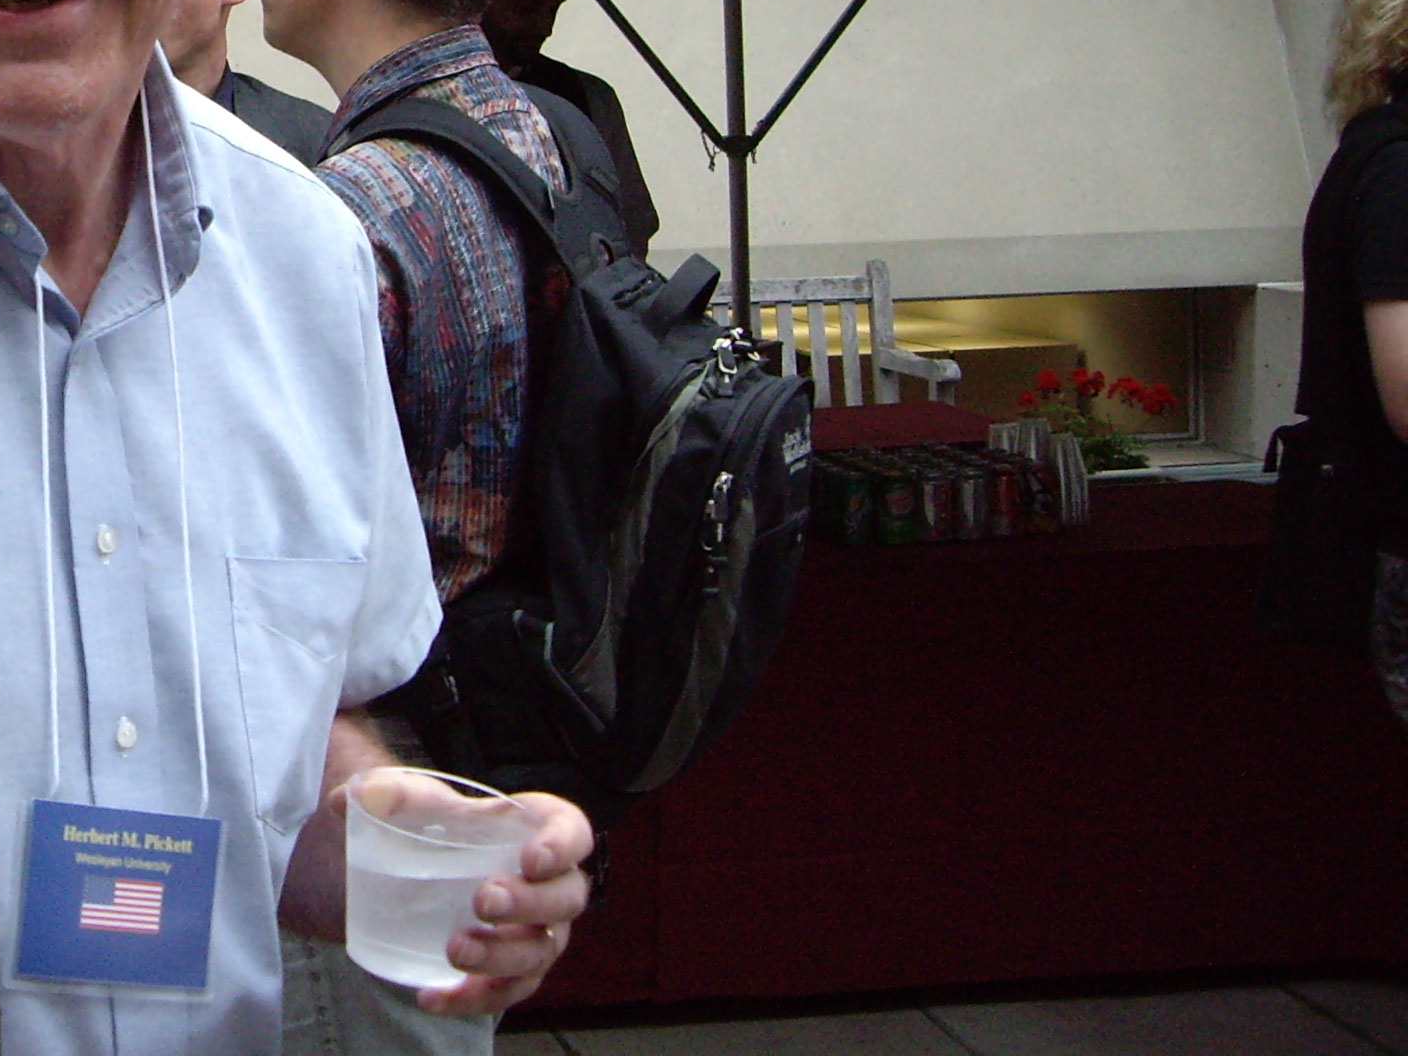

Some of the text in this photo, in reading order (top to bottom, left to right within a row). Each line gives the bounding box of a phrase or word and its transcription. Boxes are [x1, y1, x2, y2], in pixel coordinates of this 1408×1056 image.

[63, 824, 193, 854] Herbert M. Pickett
[125, 858, 171, 875] University
